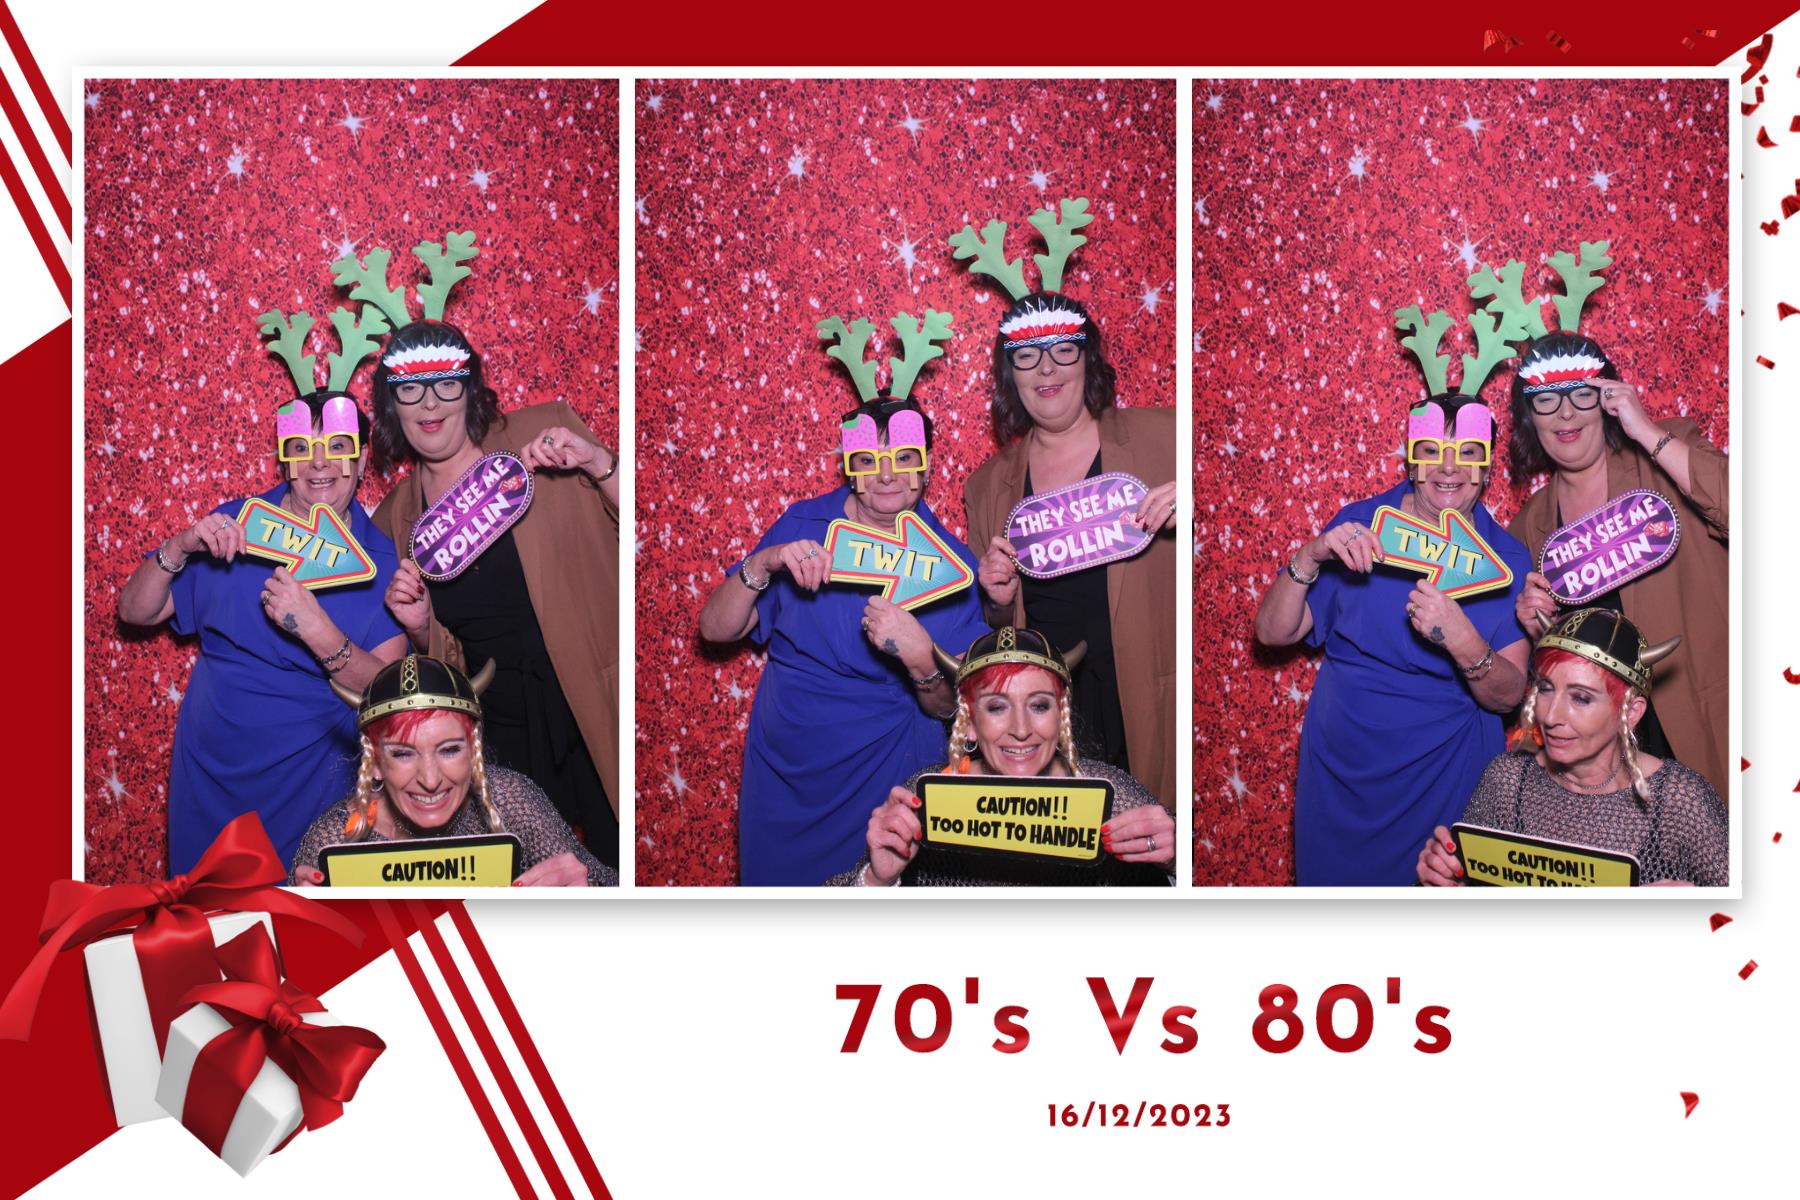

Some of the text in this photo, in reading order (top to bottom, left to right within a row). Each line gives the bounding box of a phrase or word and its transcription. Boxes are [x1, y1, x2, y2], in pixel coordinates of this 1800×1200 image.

[415, 457, 510, 550] THEY SEE ME
[1015, 483, 1138, 538] THEY SEE ME
[259, 517, 349, 567] TWIT
[433, 493, 512, 571] ROLLIN
[1029, 520, 1126, 569] ROLLIN
[1394, 526, 1484, 575] TWIT
[1547, 496, 1659, 569] THEY SEE ME
[848, 540, 942, 581] TWIT
[1562, 532, 1653, 595] ROLLIN
[976, 796, 1068, 820] CAUTION!!
[930, 816, 1097, 850] TOO HOT TO HANDLE
[381, 855, 476, 882] CAUTION!!
[1467, 858, 1499, 877] TOO
[1502, 867, 1534, 887] HOT
[1507, 850, 1596, 884] CAUTION!!
